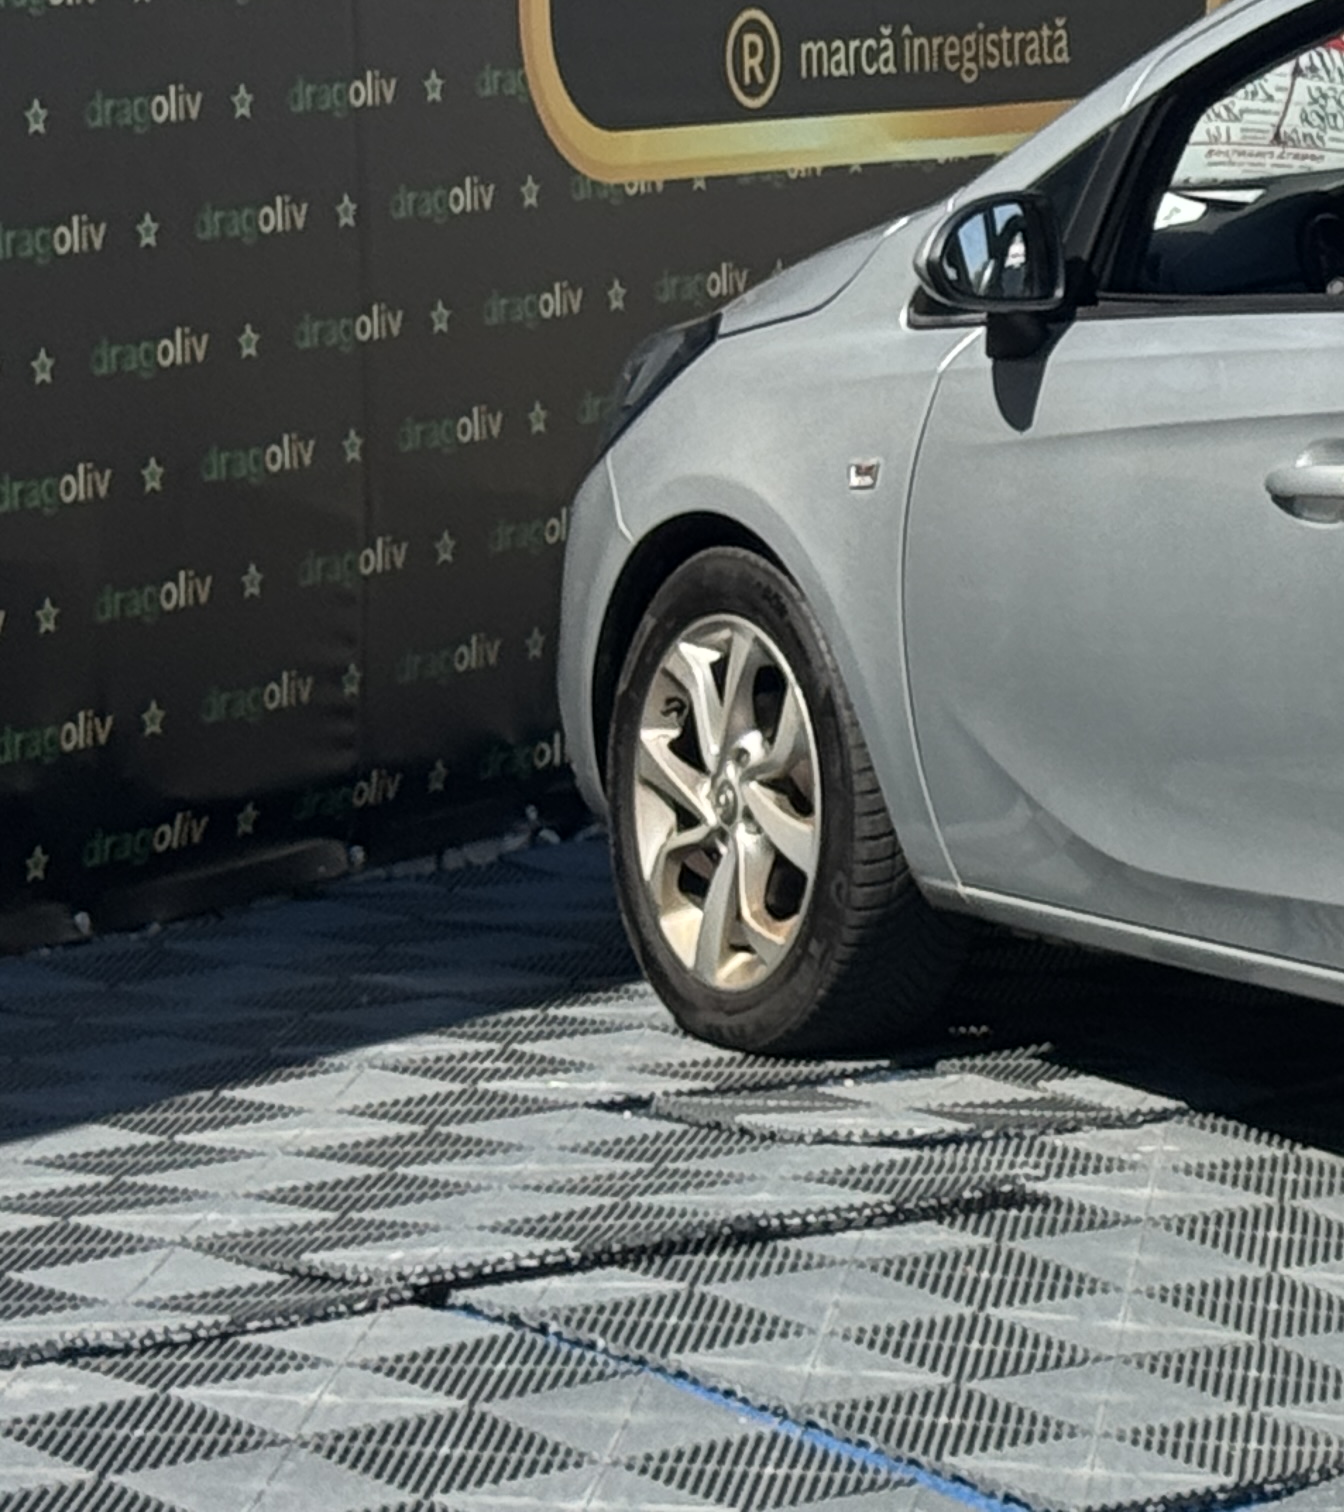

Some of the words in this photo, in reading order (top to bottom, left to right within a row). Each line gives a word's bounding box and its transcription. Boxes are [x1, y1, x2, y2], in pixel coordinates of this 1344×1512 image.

[800, 24, 896, 79] marcă
[901, 17, 1071, 84] înregistrată
[85, 83, 203, 134] dragoliv
[287, 69, 398, 118] dragoliv
[194, 194, 308, 245] dragoliv
[388, 175, 495, 224] dragoliv
[293, 301, 404, 352] dragoliv
[90, 326, 210, 379] dragoliv
[201, 433, 317, 484] dragoliv
[94, 570, 213, 624] dragoliv
